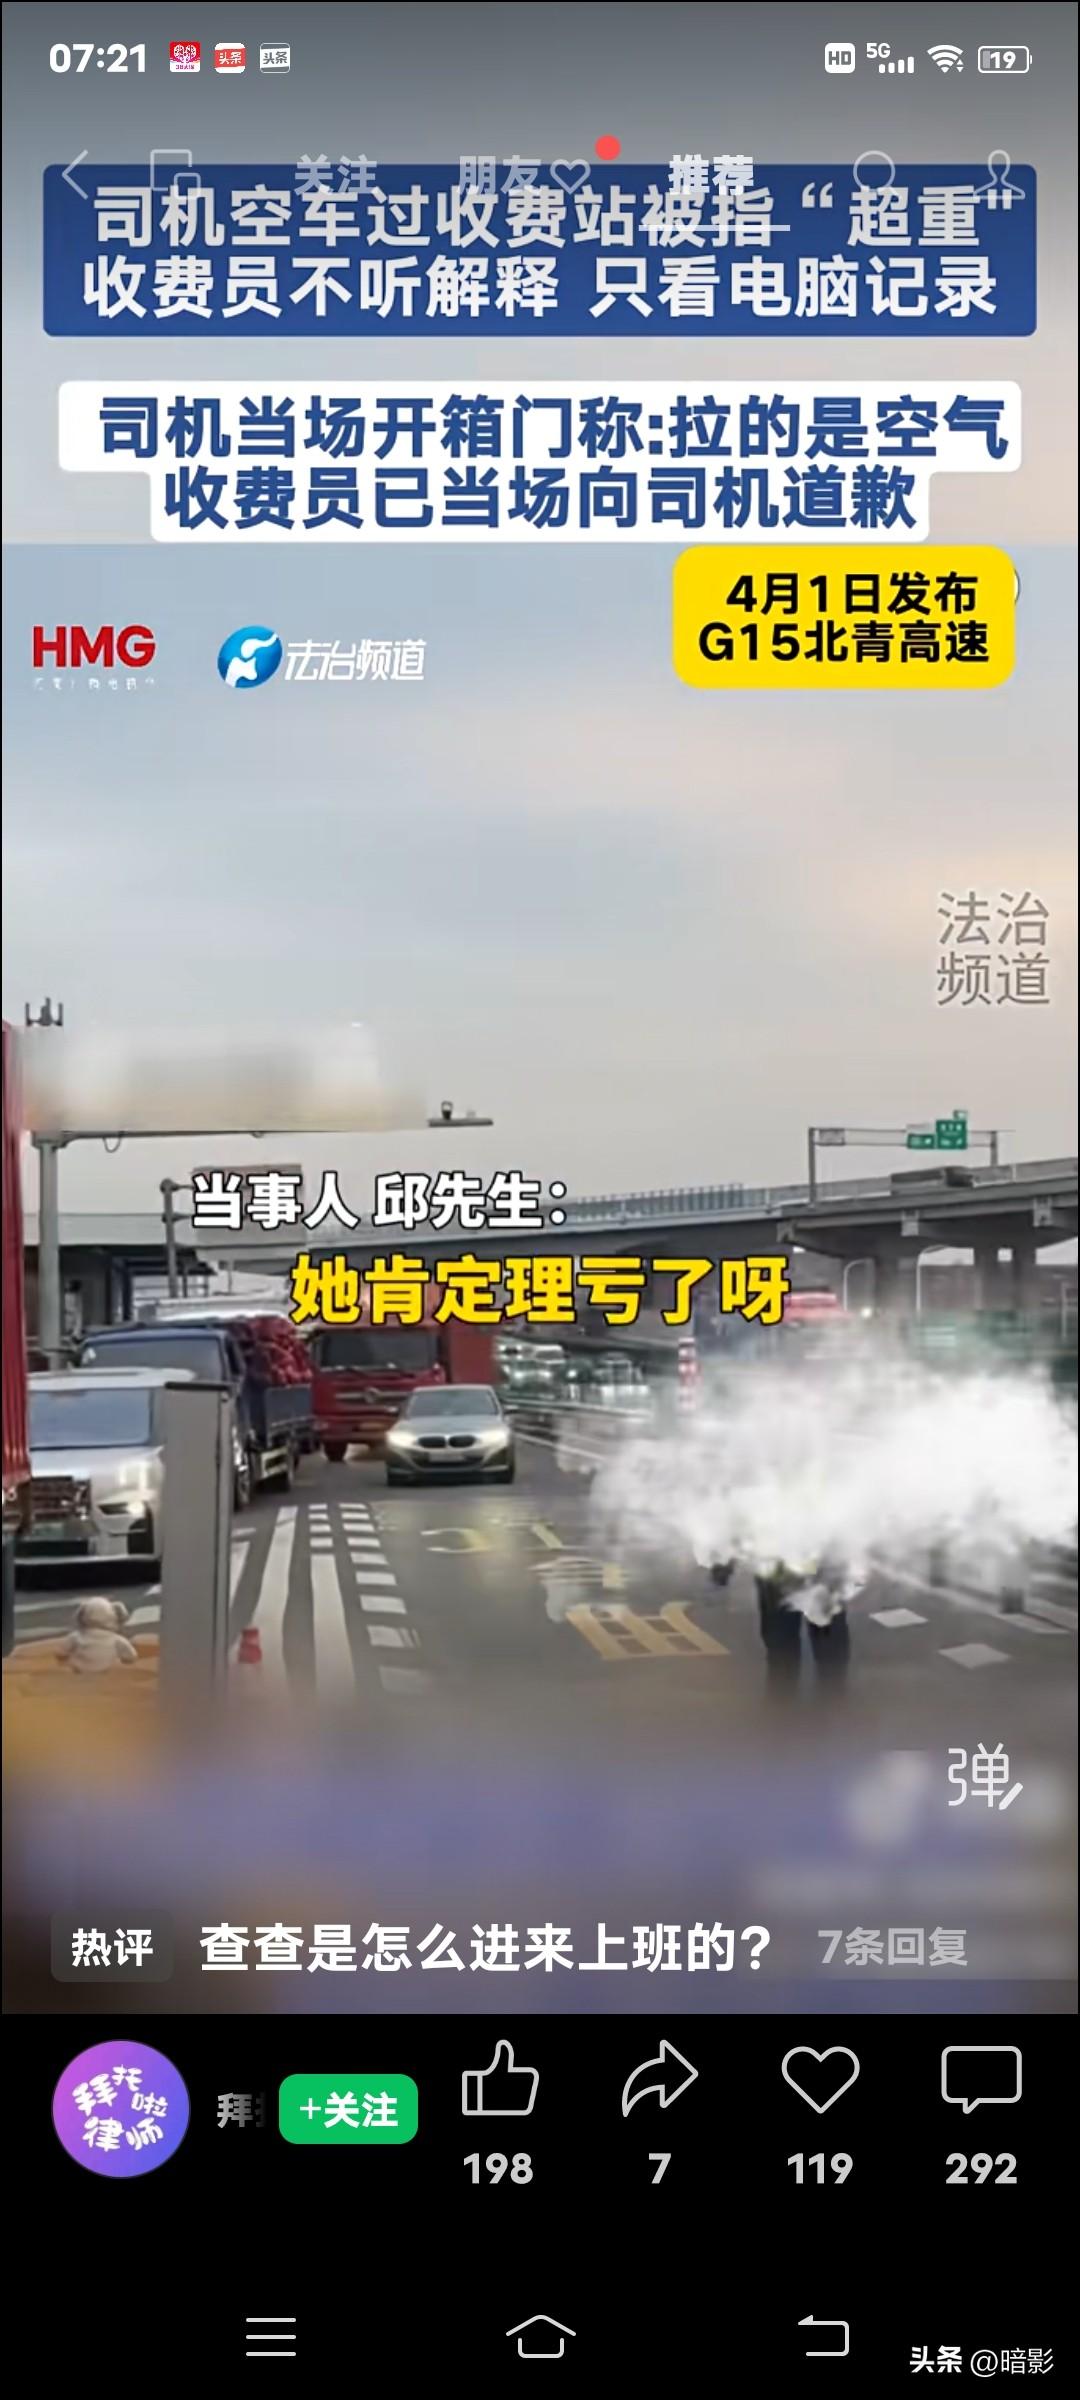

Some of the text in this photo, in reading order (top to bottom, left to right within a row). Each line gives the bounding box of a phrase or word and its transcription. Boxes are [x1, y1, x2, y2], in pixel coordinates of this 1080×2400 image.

[49, 43, 146, 73] 07:21
[262, 51, 288, 65] 头条
[866, 43, 891, 59] 5G
[990, 51, 1016, 69] 19
[294, 154, 377, 195] 关注
[457, 154, 541, 195] 朋友
[668, 154, 754, 196] 推荐
[71, 1927, 154, 1968] 热评
[199, 1921, 771, 1974] 查查是怎么进来上班的?
[817, 1926, 969, 1968] 7条回复
[217, 2092, 265, 2129] 拜
[463, 2152, 534, 2185] 198
[648, 2152, 672, 2185] 7
[787, 2152, 854, 2185] 119
[945, 2152, 1018, 2185] 292
